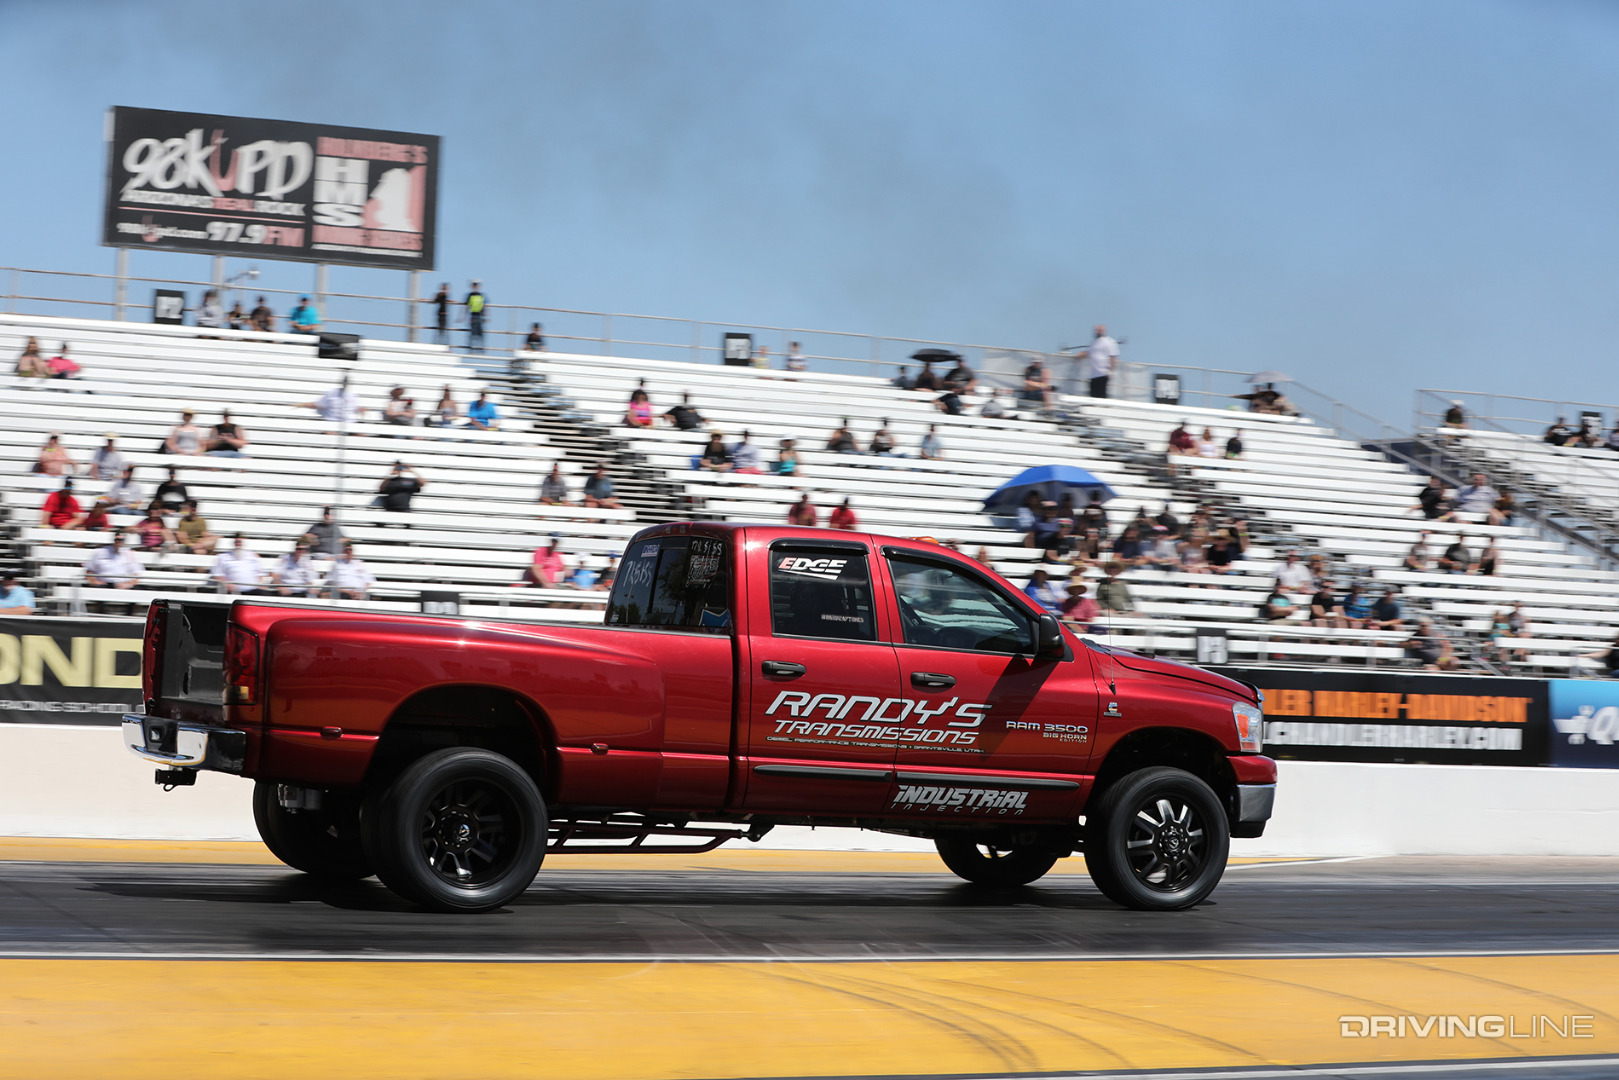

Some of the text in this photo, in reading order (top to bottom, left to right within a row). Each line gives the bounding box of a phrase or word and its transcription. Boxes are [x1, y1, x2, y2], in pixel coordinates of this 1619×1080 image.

[778, 557, 848, 574] EDGE
[765, 690, 992, 728] RANDY'S
[774, 719, 980, 745] TRANSMISSIONS
[1005, 721, 1088, 734] RAM 3500
[794, 738, 849, 746] PERFORMANCE
[851, 741, 908, 749] TRANSMISSIONS
